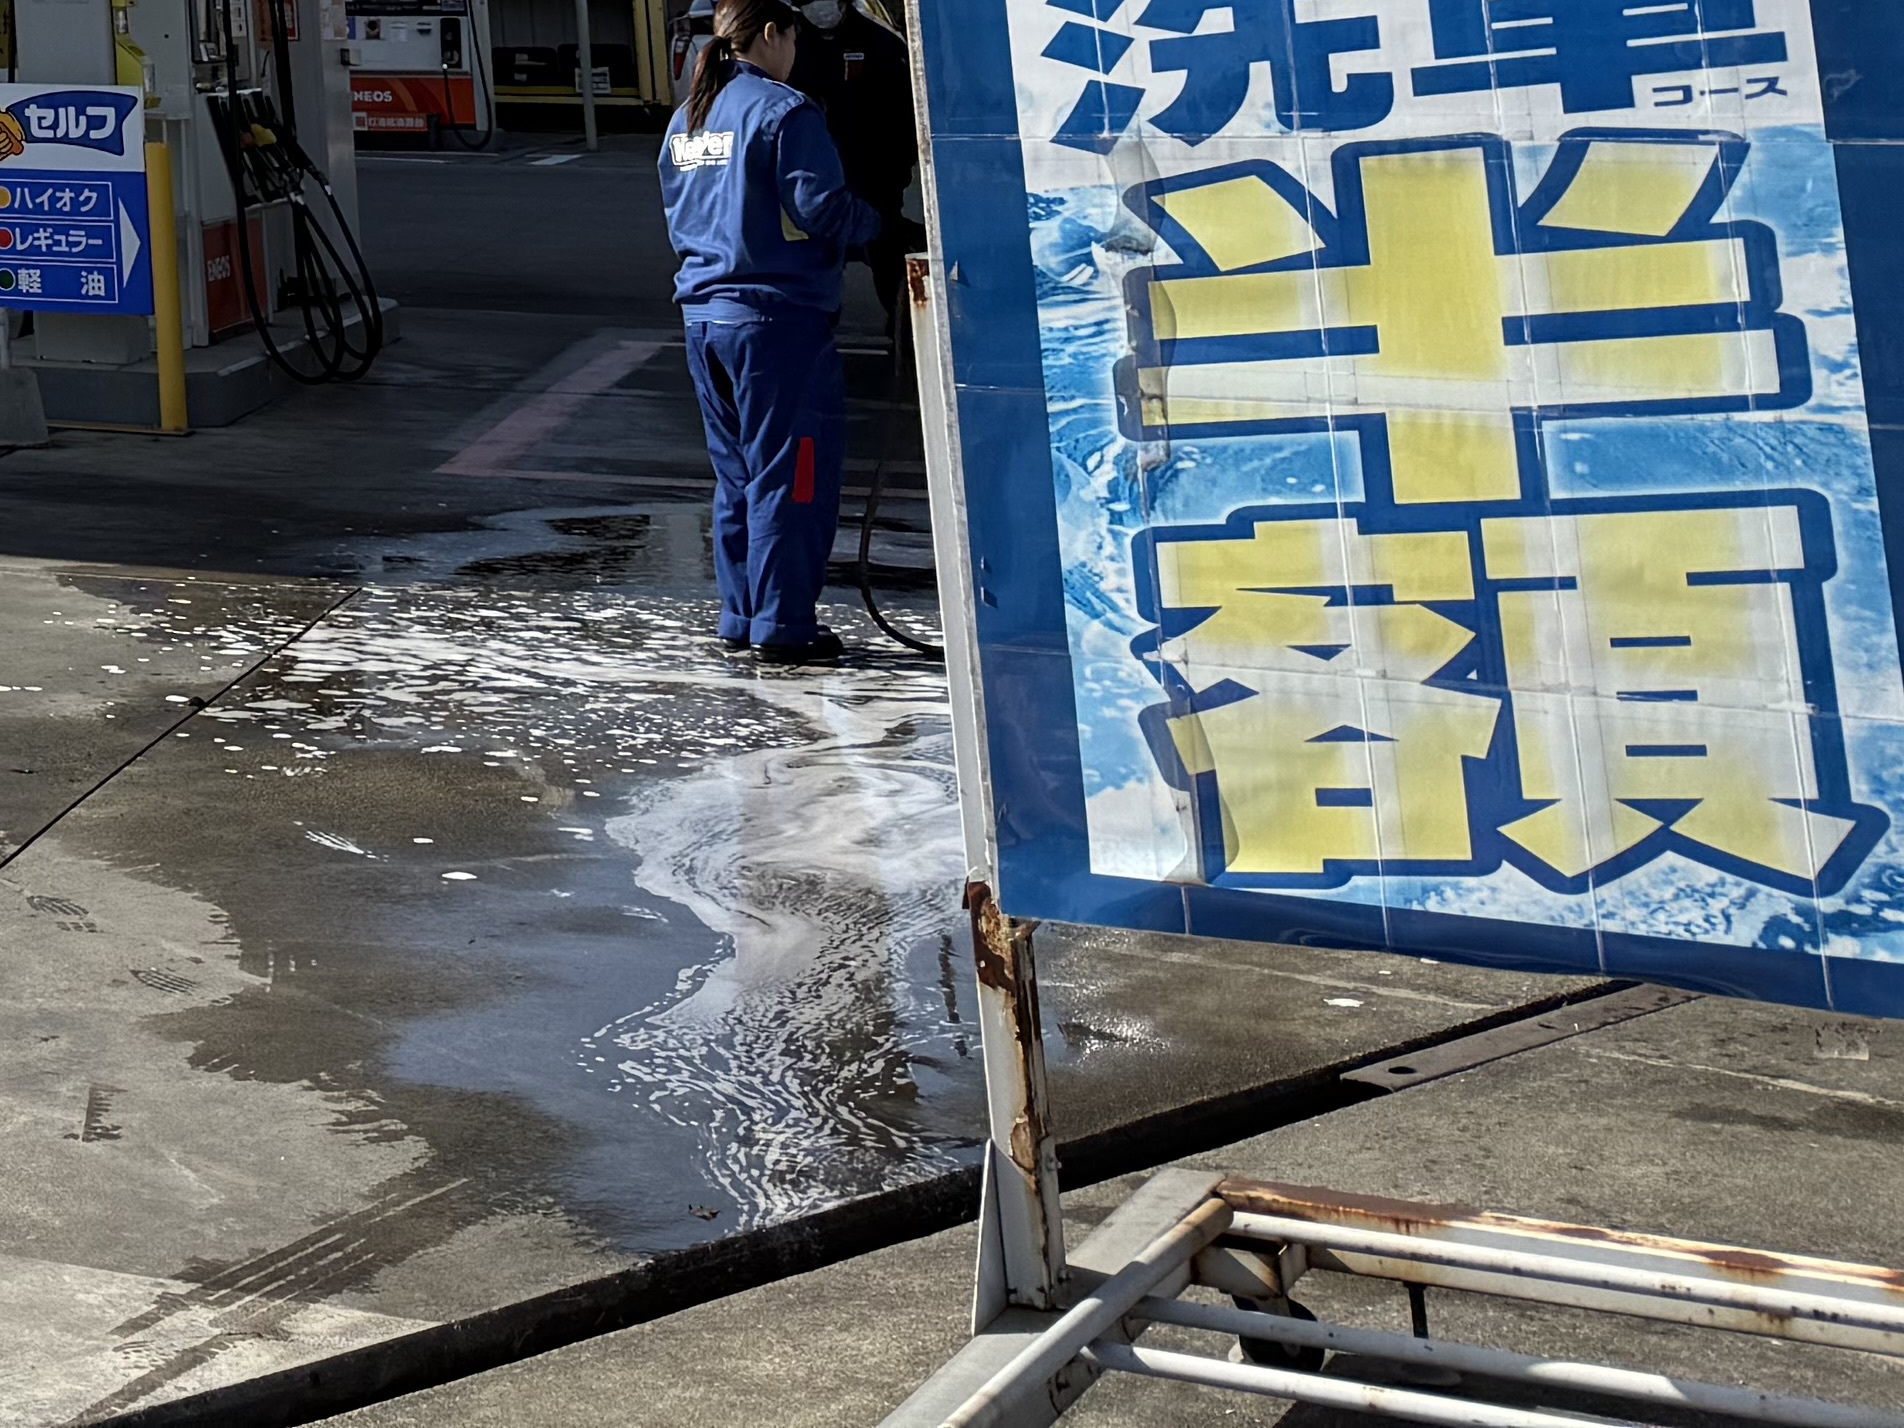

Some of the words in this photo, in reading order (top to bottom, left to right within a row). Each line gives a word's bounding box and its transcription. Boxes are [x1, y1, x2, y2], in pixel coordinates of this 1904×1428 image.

[353, 90, 393, 103] NEOS
[1651, 77, 1790, 108] コース
[24, 104, 118, 140] セルフ
[13, 187, 99, 213] ハイオク
[13, 227, 104, 253] レギュラー
[206, 255, 232, 283] ENEOS
[1117, 132, 1885, 892] 半額
